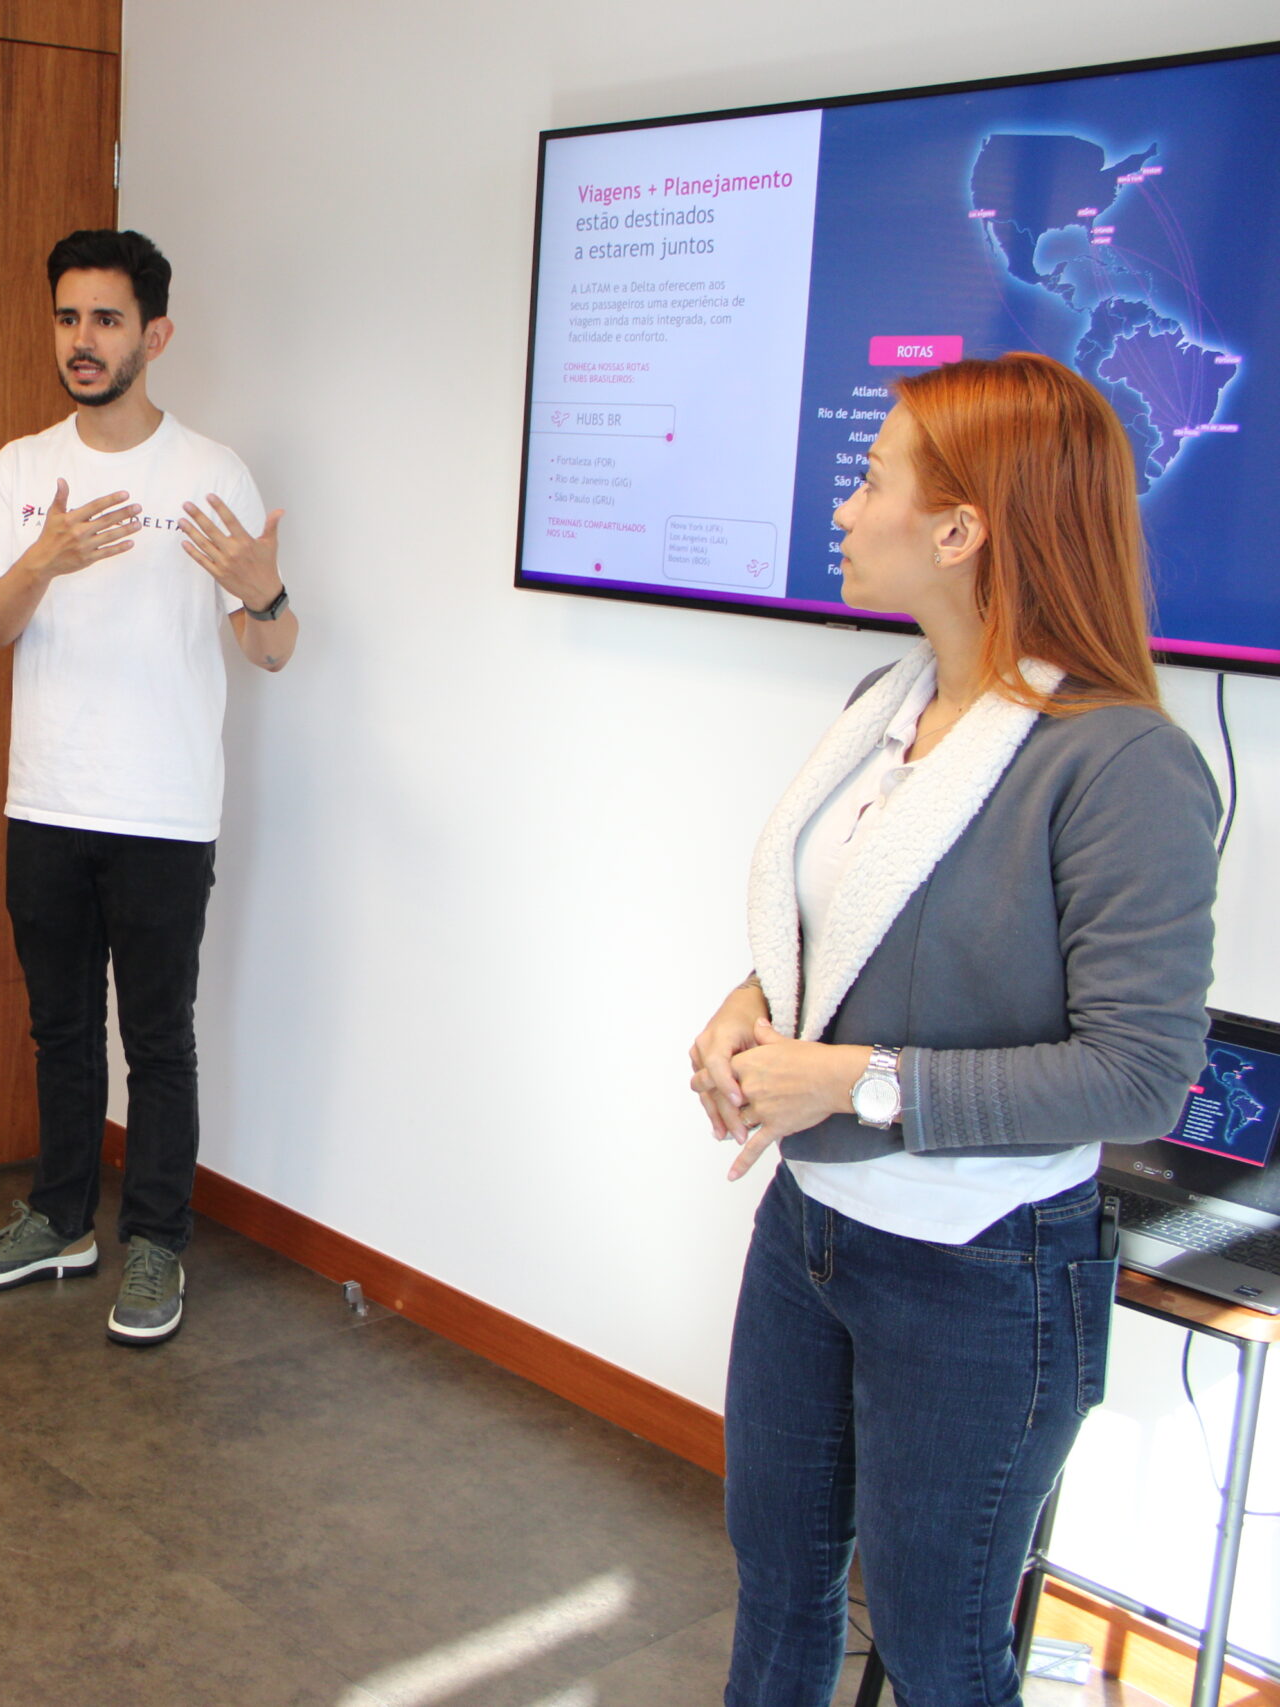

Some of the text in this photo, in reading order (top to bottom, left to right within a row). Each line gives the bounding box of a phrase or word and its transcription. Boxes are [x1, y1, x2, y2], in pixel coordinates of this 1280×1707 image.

[578, 170, 793, 206] Viagens + Planejamento
[576, 205, 715, 232] estão destinados
[574, 237, 715, 260] a estarem juntos
[570, 280, 726, 294] A LATAM e a Delta oferecem aos
[570, 294, 745, 312] seus passageiros uma experiência de
[569, 314, 732, 329] viagem ainda mais integrada, com
[568, 331, 668, 343] facilidade e conforto.
[897, 345, 934, 358] ROTAS
[563, 362, 650, 373] CONHEÇA NOSSAS ROTAS
[563, 374, 568, 383] E
[569, 374, 587, 383] HUBS
[852, 386, 888, 397] Atlanta
[577, 412, 622, 426] HUBS BR
[817, 408, 887, 420] Rio de Janeiro
[848, 432, 879, 442] Atlant
[556, 456, 616, 468] Fortaleza (FOR)
[836, 453, 853, 464] São
[556, 474, 568, 483] Rio
[570, 475, 578, 484] de
[581, 476, 609, 486] Janeiro
[834, 475, 851, 486] São
[554, 492, 568, 502] São
[569, 493, 590, 504] Paulo
[548, 517, 582, 528] TERMINAIS
